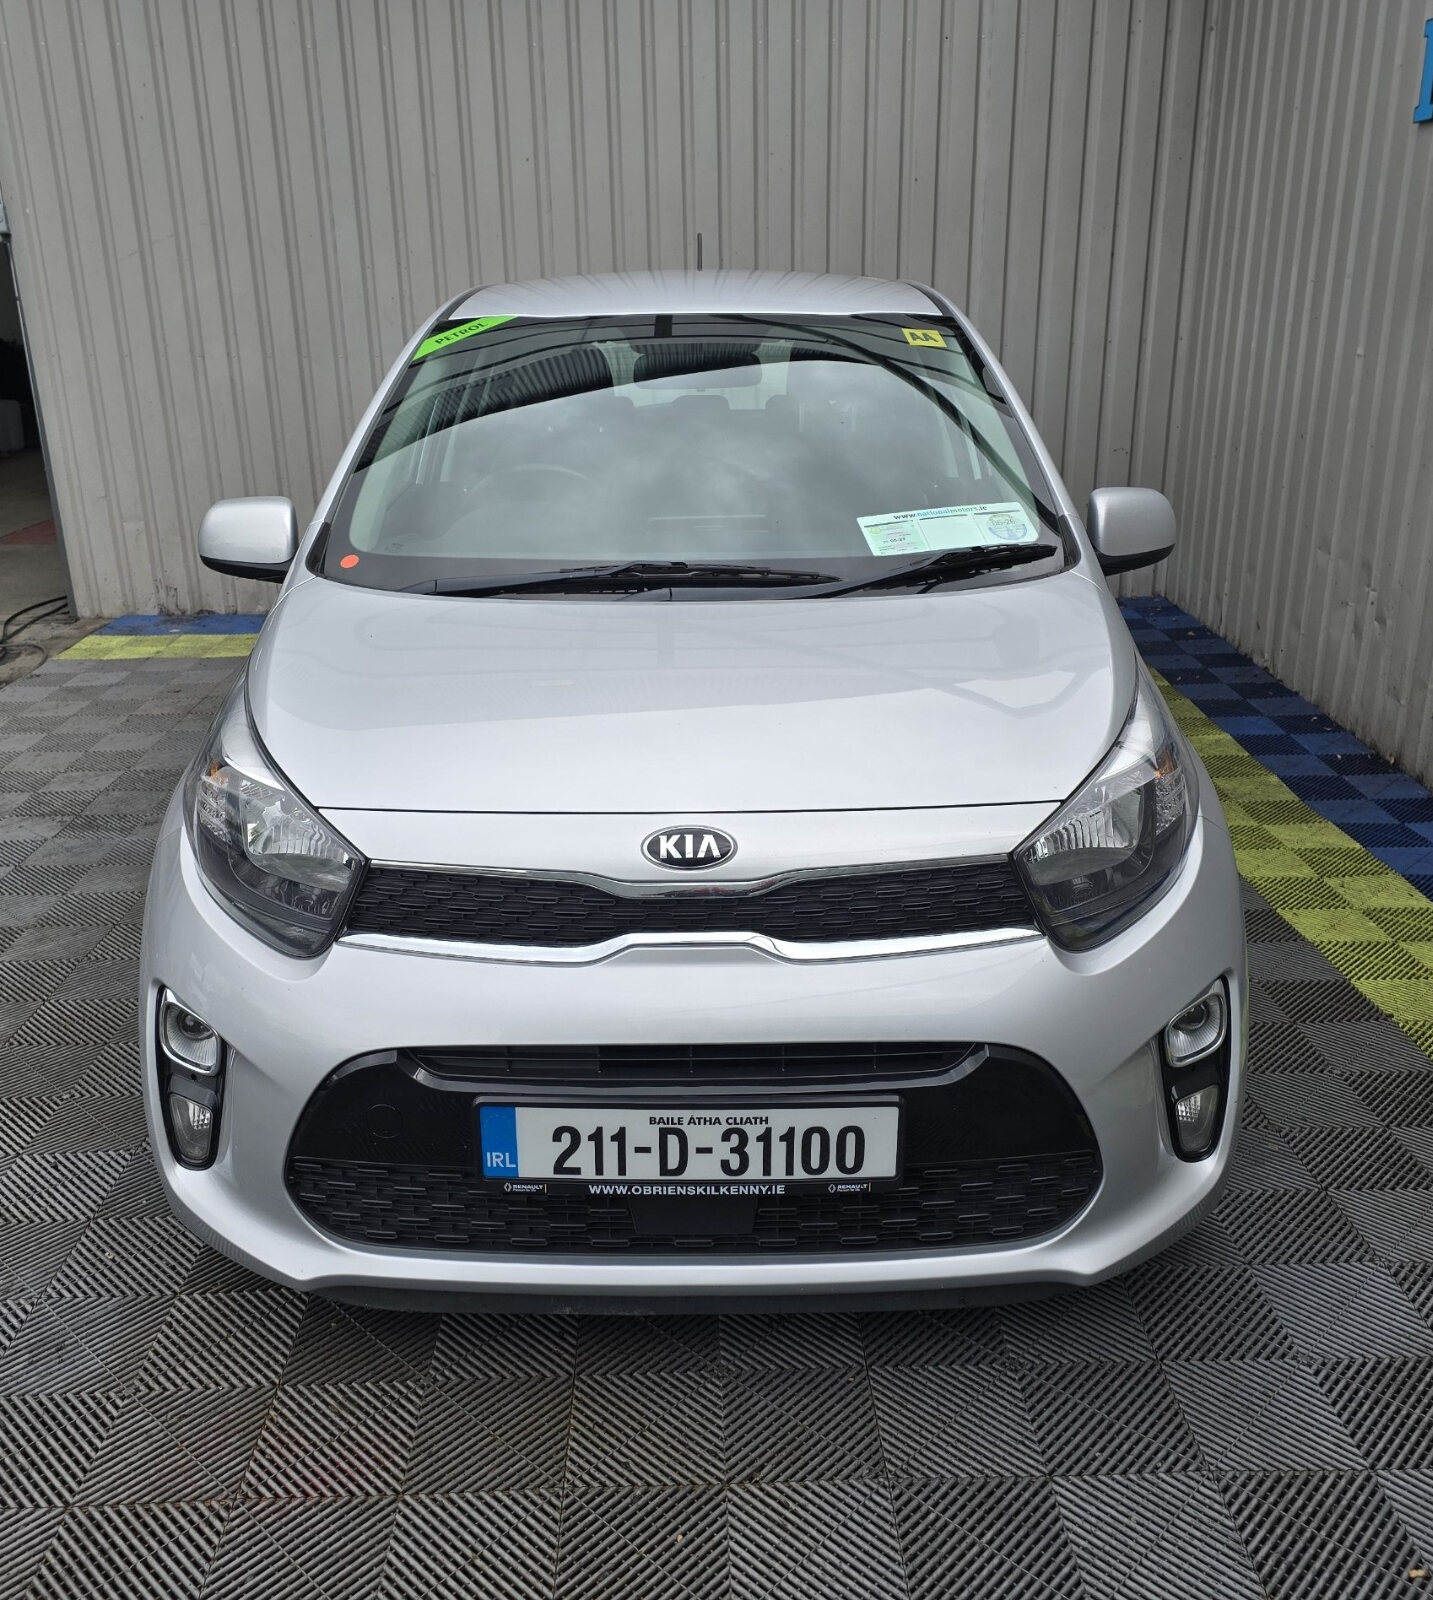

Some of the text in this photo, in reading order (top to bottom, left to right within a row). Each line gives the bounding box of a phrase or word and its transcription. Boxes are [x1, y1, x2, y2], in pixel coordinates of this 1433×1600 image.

[435, 323, 488, 344] PETROL
[909, 332, 939, 342] AA
[893, 506, 988, 520] www.nationalmotors.ie
[658, 834, 722, 859] KIA
[649, 1115, 769, 1126] BAILE ÁTHA CLIATH
[552, 1125, 866, 1177] 211-D-31100
[486, 1152, 517, 1168] IRL
[588, 1184, 786, 1195] WWW.OBRIENSKILKENNY.IE
